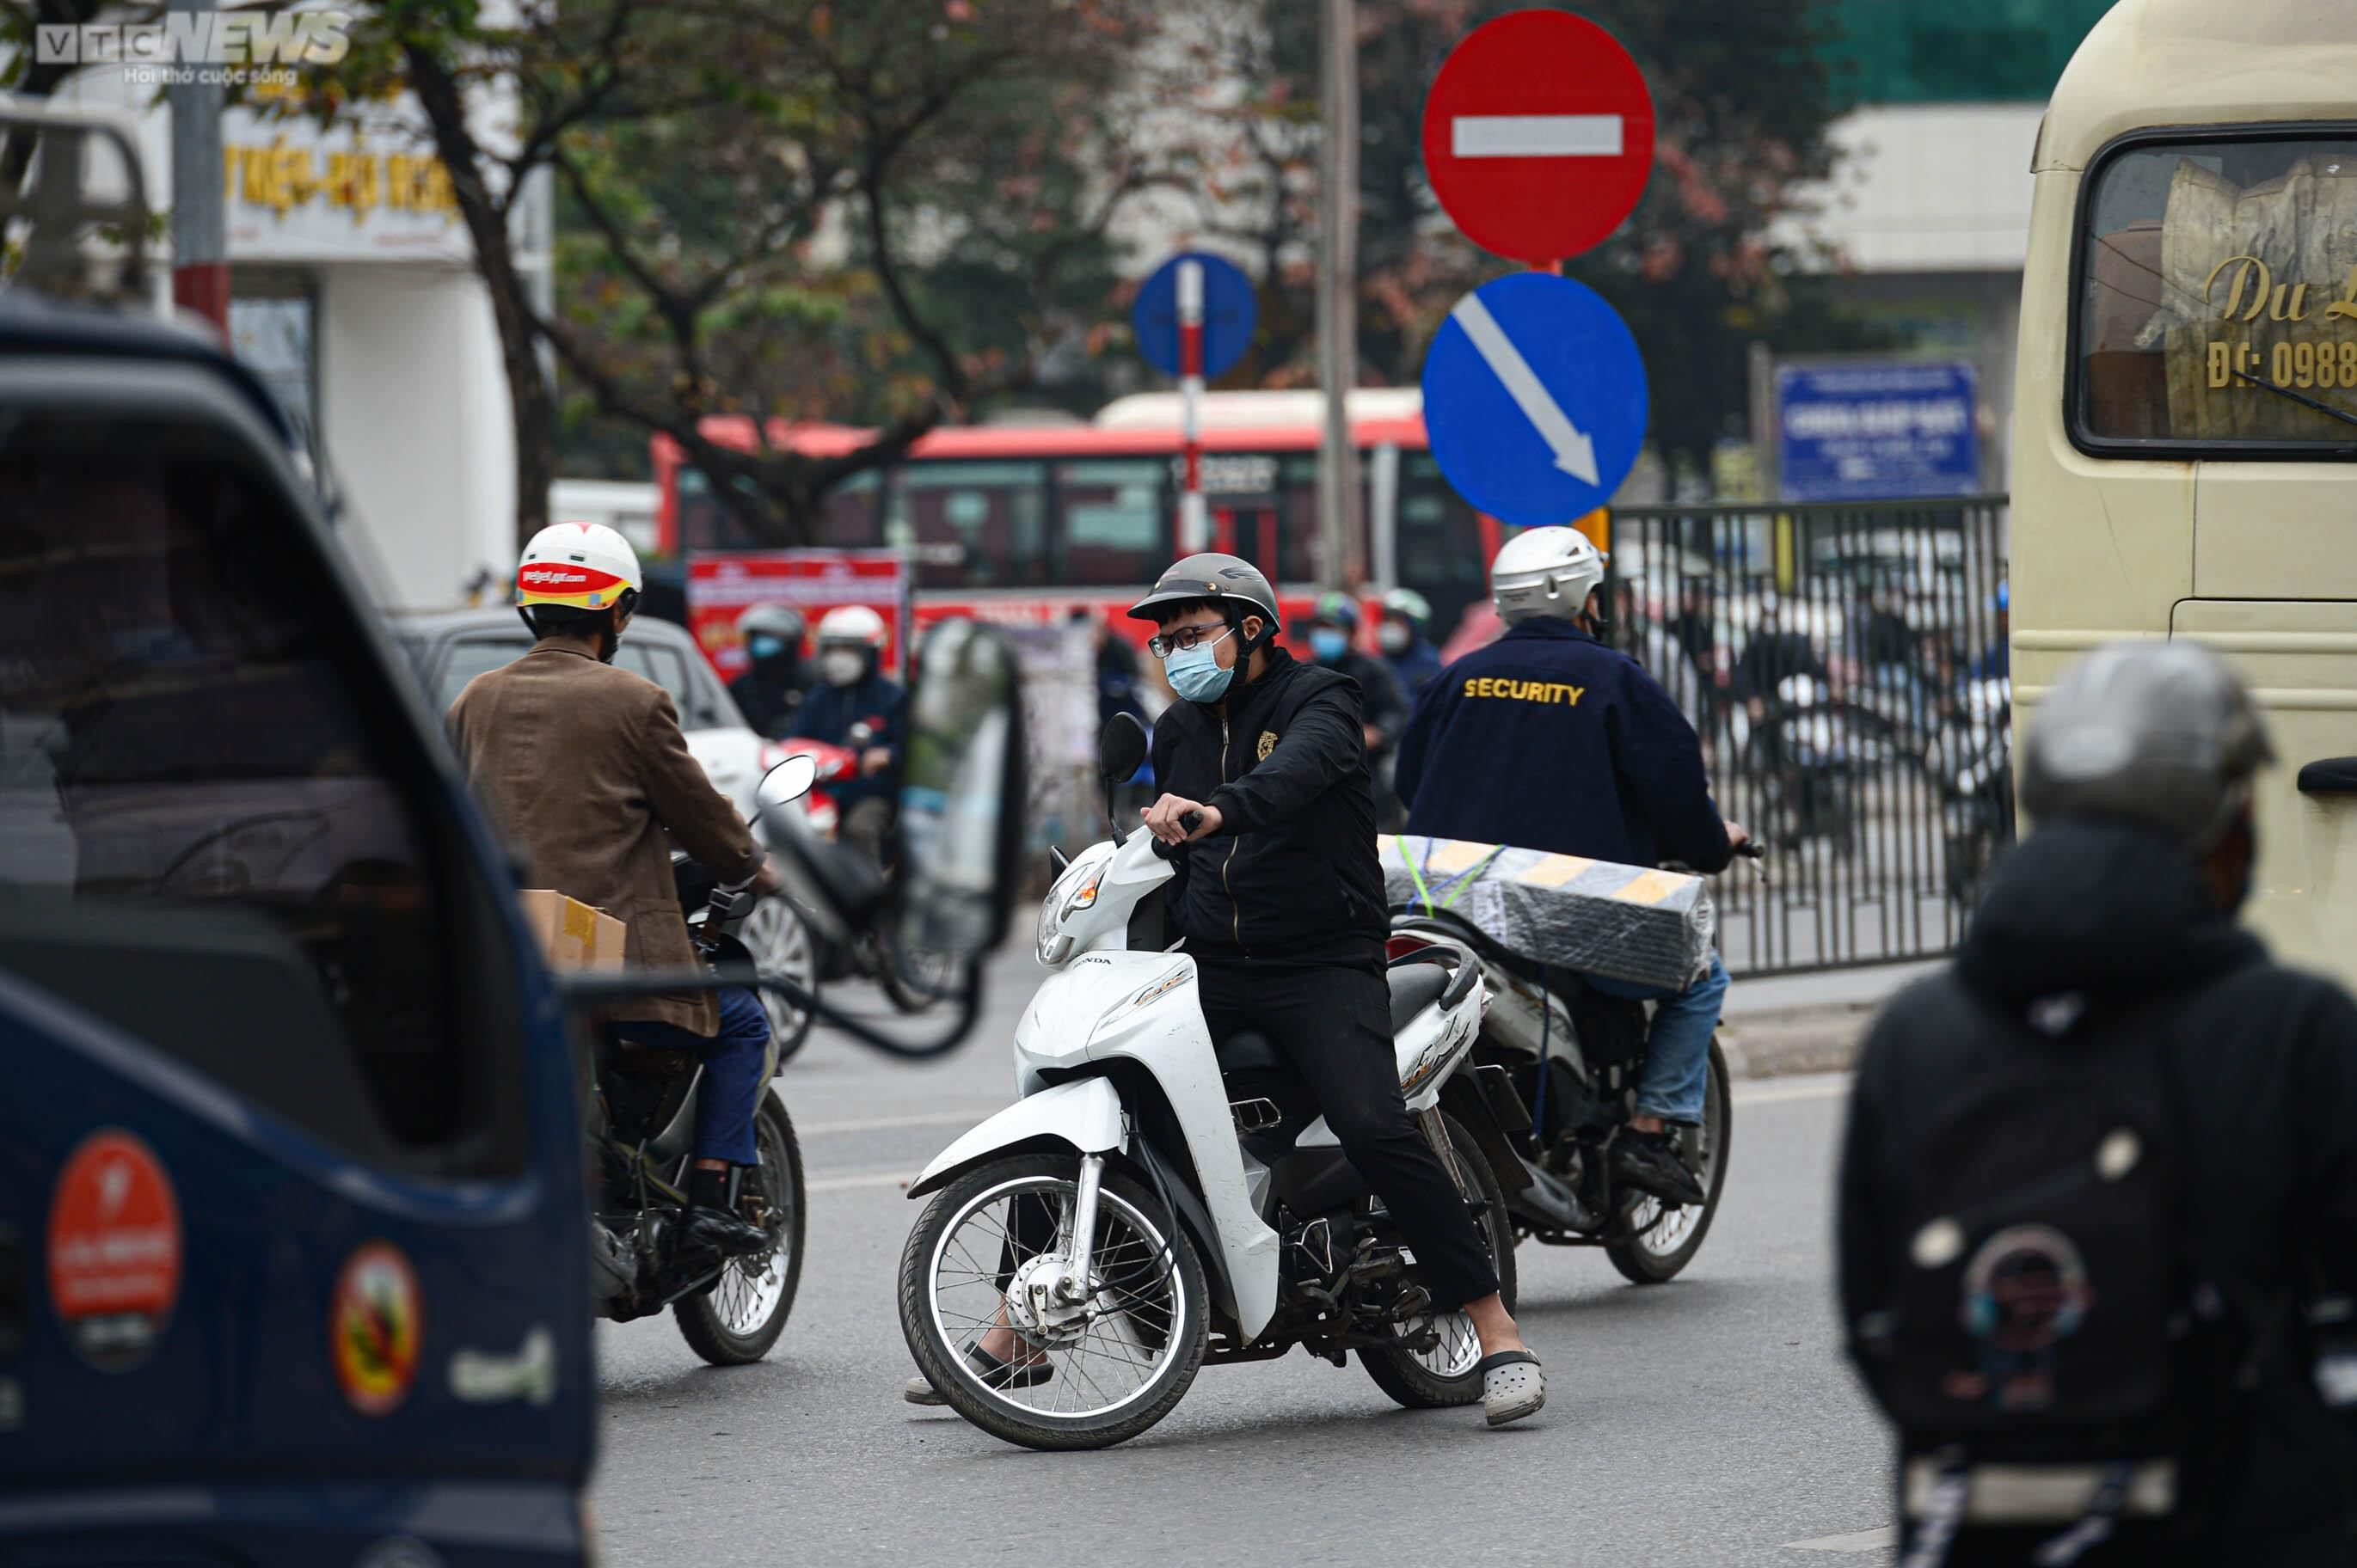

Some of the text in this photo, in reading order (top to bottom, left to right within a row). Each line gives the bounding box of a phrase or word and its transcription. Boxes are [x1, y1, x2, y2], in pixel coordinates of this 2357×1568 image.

[2204, 255, 2311, 322] Du
[2272, 341, 2357, 388] 0988
[1464, 677, 1585, 707] SECURITY
